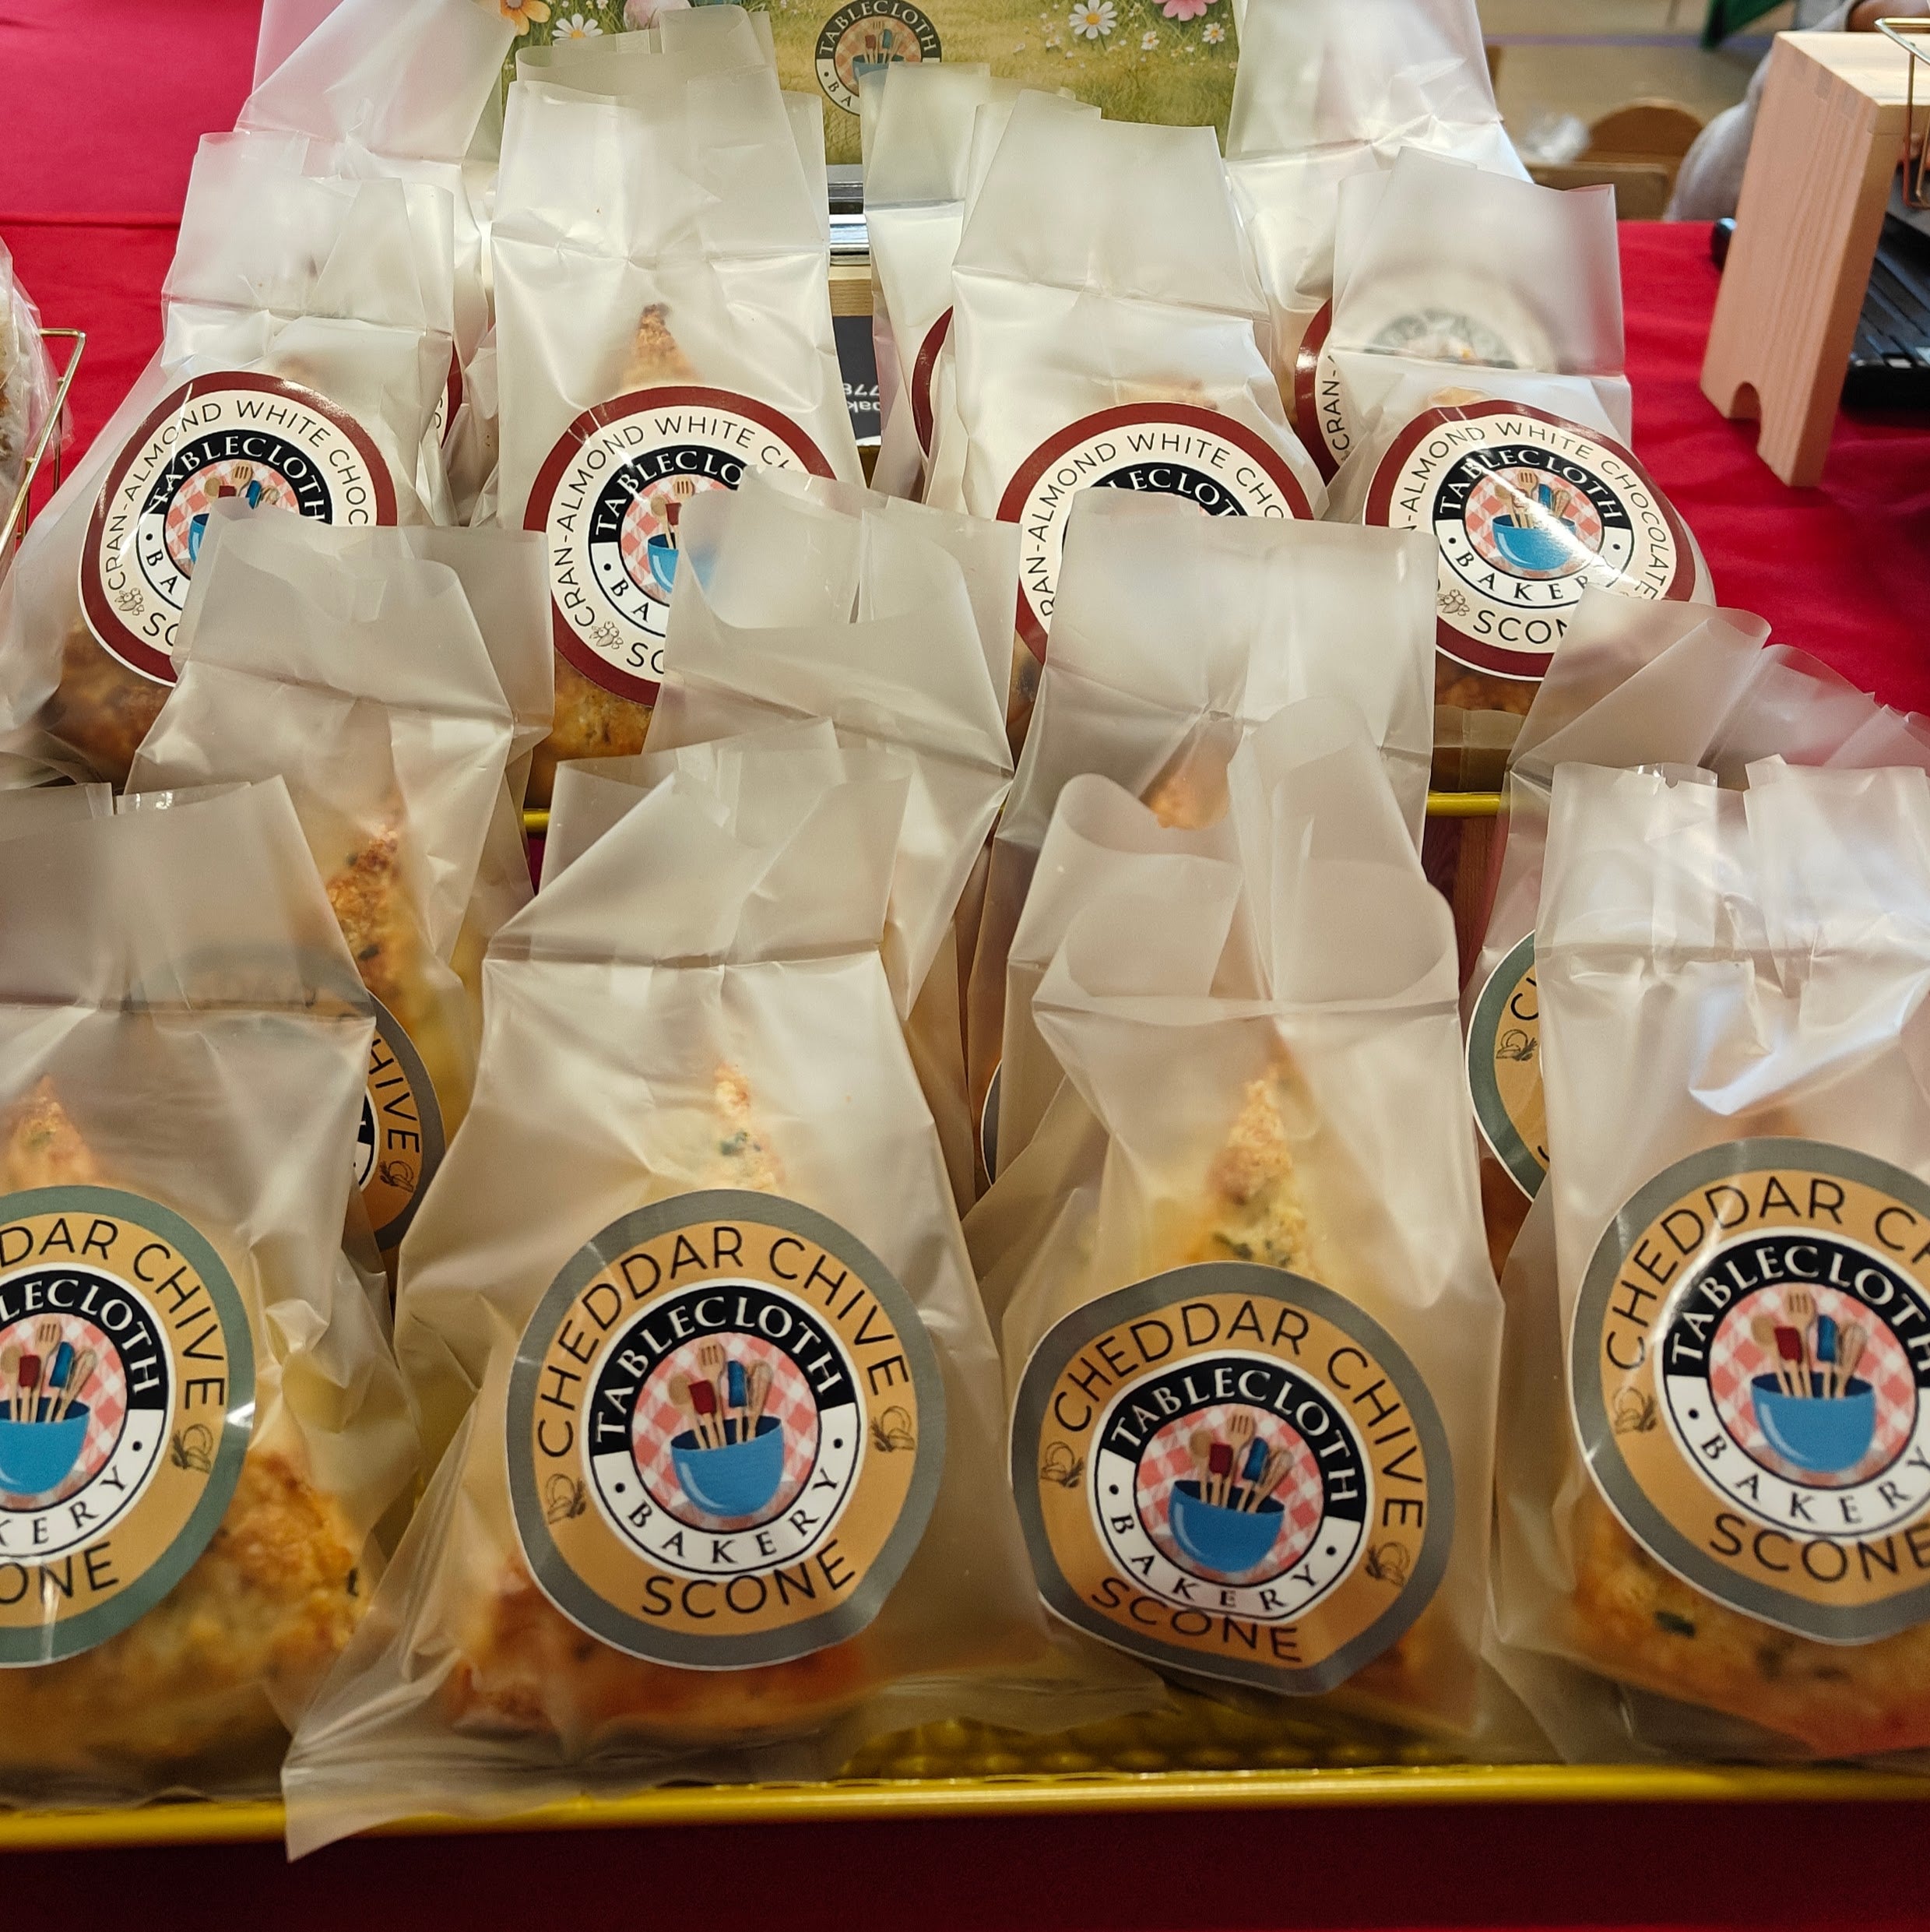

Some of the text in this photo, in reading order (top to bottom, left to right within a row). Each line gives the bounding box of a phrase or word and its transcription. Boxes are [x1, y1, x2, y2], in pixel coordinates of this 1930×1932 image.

[819, 0, 937, 55] TABLECLOTH
[106, 401, 222, 591] CRAN-ALMOND
[237, 399, 332, 448] WHITE
[149, 435, 325, 523] TABLECLOTH
[1127, 433, 1231, 470] WHITE
[1439, 449, 1622, 519] TABLECLOTH
[1496, 421, 1594, 460] WHITE
[1601, 459, 1669, 599] CHOCOLATE
[554, 415, 755, 627] CRAN-ALMOND WHITE
[134, 1244, 225, 1409] CHIVE
[1607, 1176, 1846, 1371] CHEDDAR
[1672, 1245, 1930, 1371] TABLECLOTH
[538, 1226, 909, 1458] CHEDDAR CHIVE
[596, 1296, 845, 1444] TABLECLOTH
[1054, 1300, 1423, 1529] CHEDDAR CHIVE
[1111, 1367, 1359, 1502] TABLECLOTH
[628, 1469, 839, 1564] BAKERY
[642, 1539, 856, 1619] SCONE
[1111, 1512, 1321, 1612] BAKERY
[1710, 1513, 1930, 1582] SCONE
[1091, 1577, 1302, 1663] SCONE
